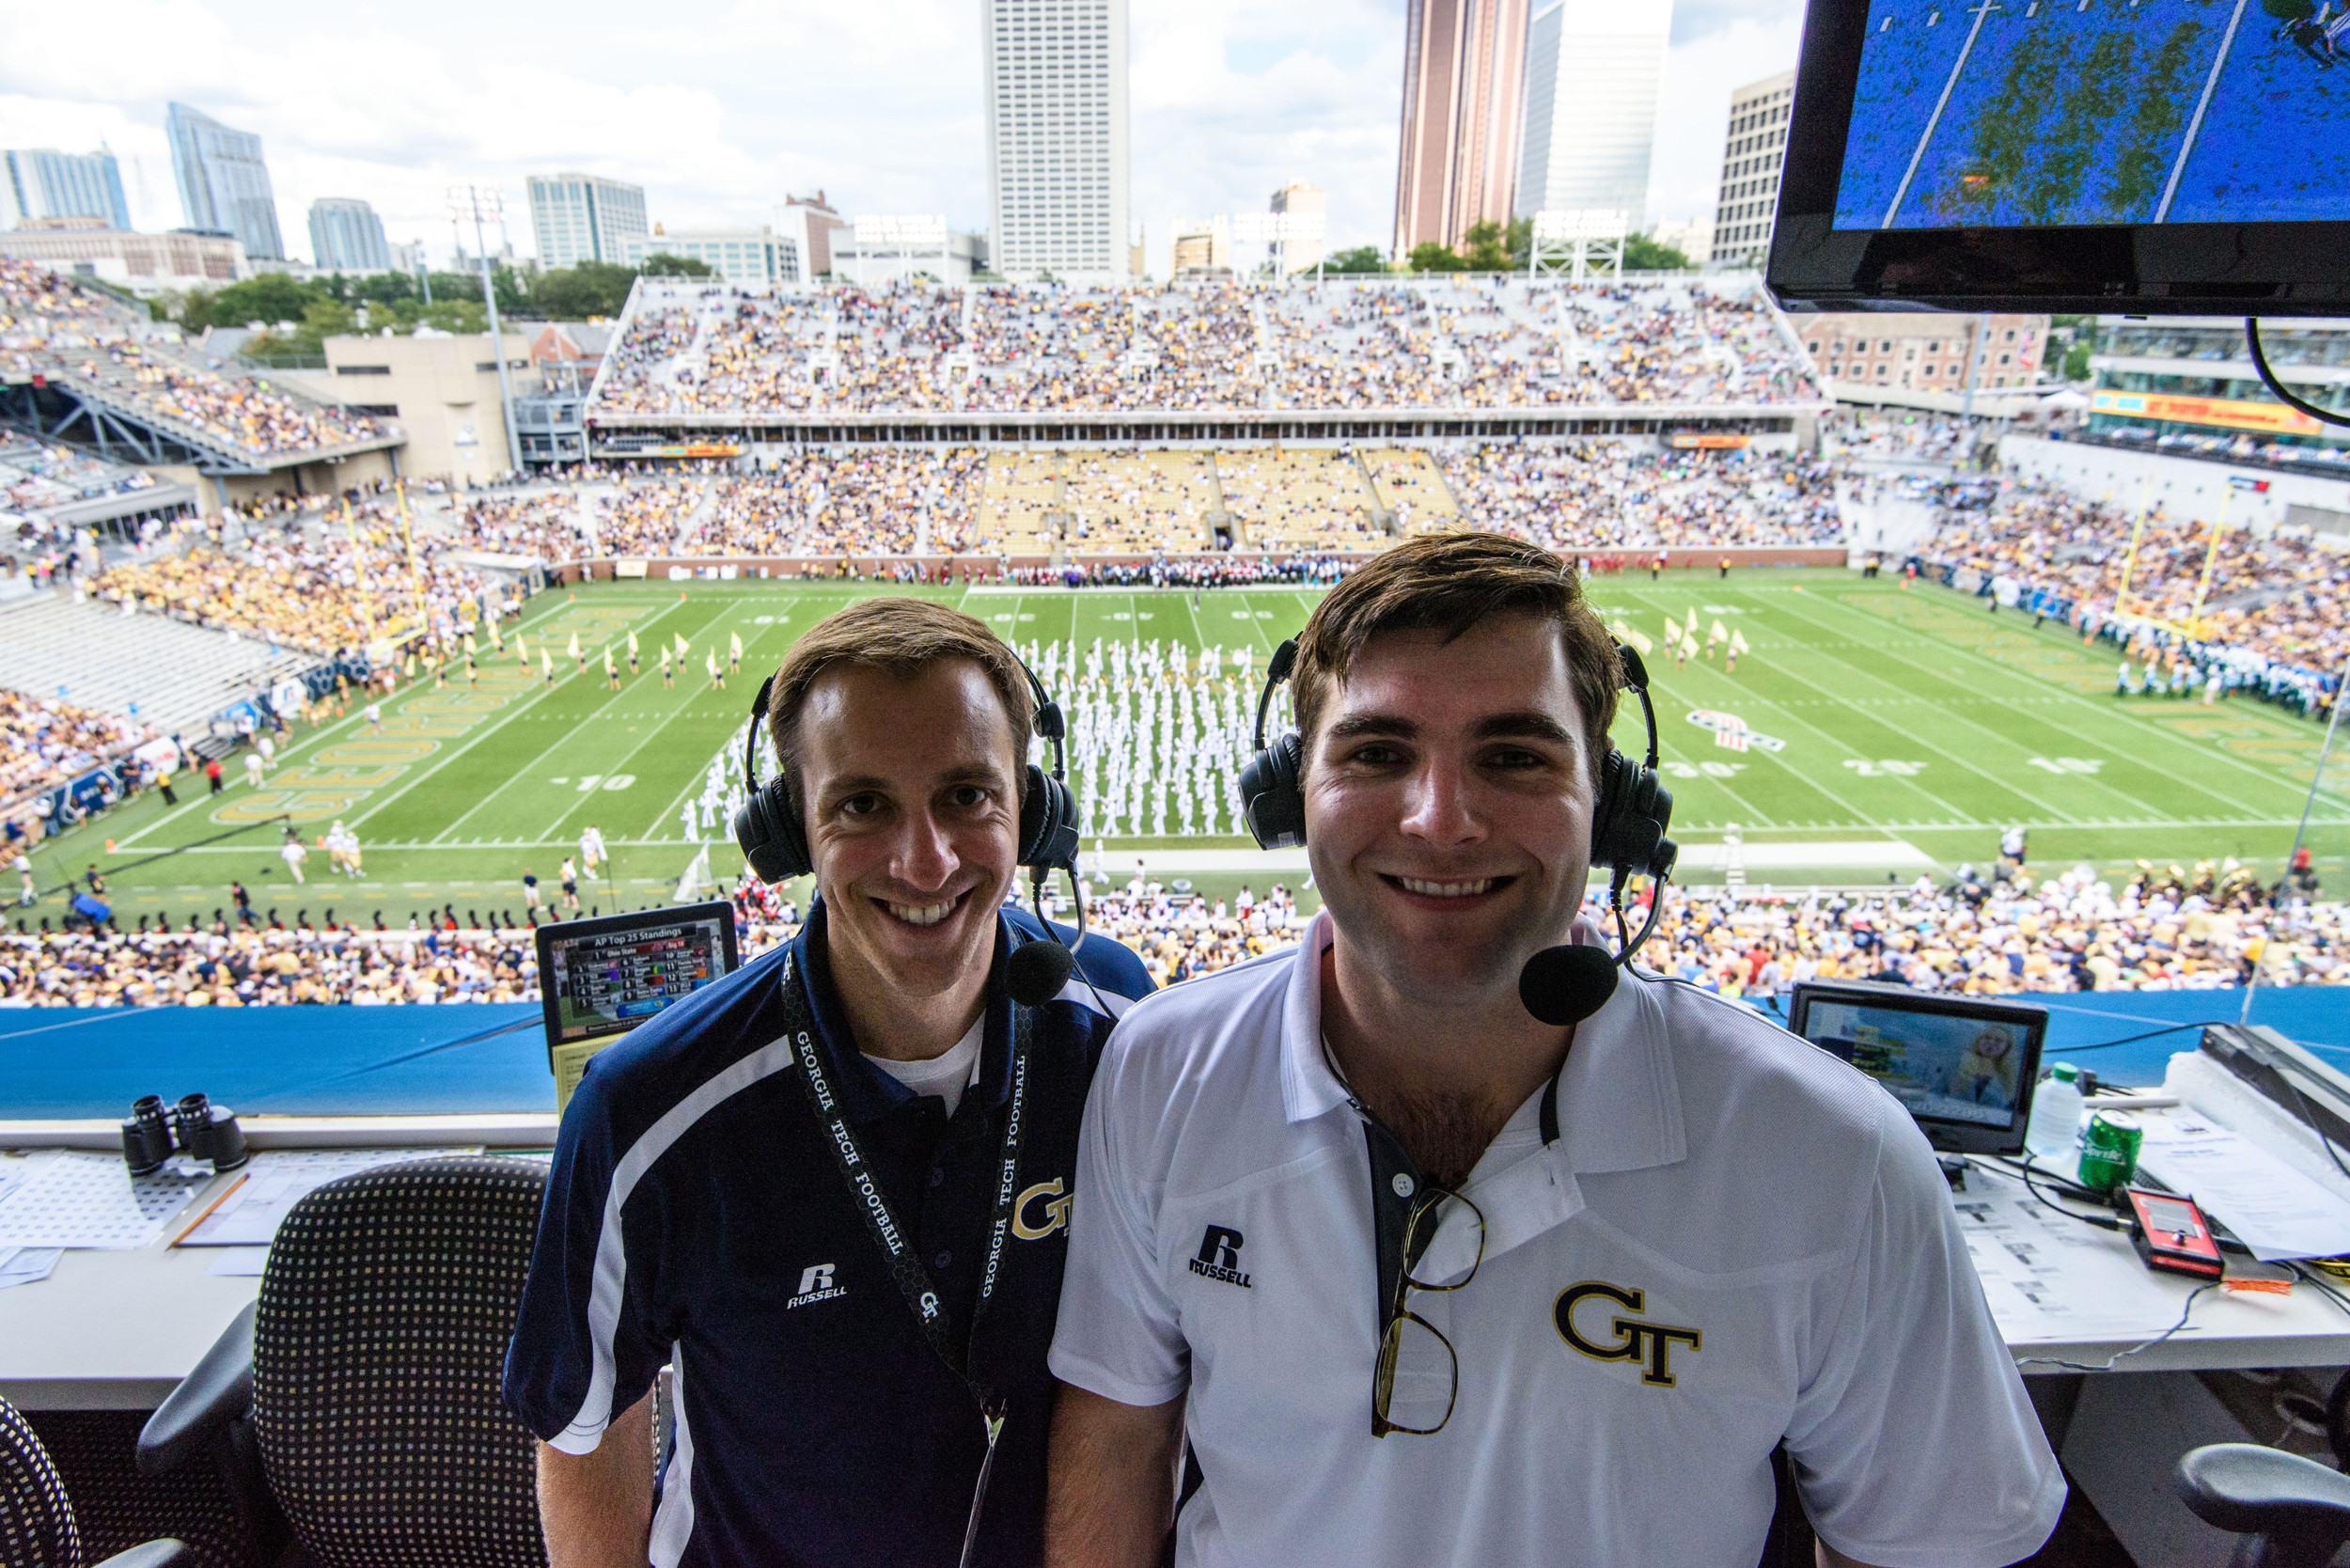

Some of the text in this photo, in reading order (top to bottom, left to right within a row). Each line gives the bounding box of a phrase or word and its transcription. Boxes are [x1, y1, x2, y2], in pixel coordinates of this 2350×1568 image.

[575, 773, 636, 792] 10
[595, 928, 682, 947] AP Top 25 Standings
[797, 1030, 904, 1255] GEORGIA TECH FOOTBALL
[982, 1055, 1026, 1298] GEORGIA TECH FOOTBALL
[1189, 1258, 1252, 1289] RUSSELL
[787, 1286, 847, 1309] RUSSELL
[1552, 1280, 1702, 1389] GT
